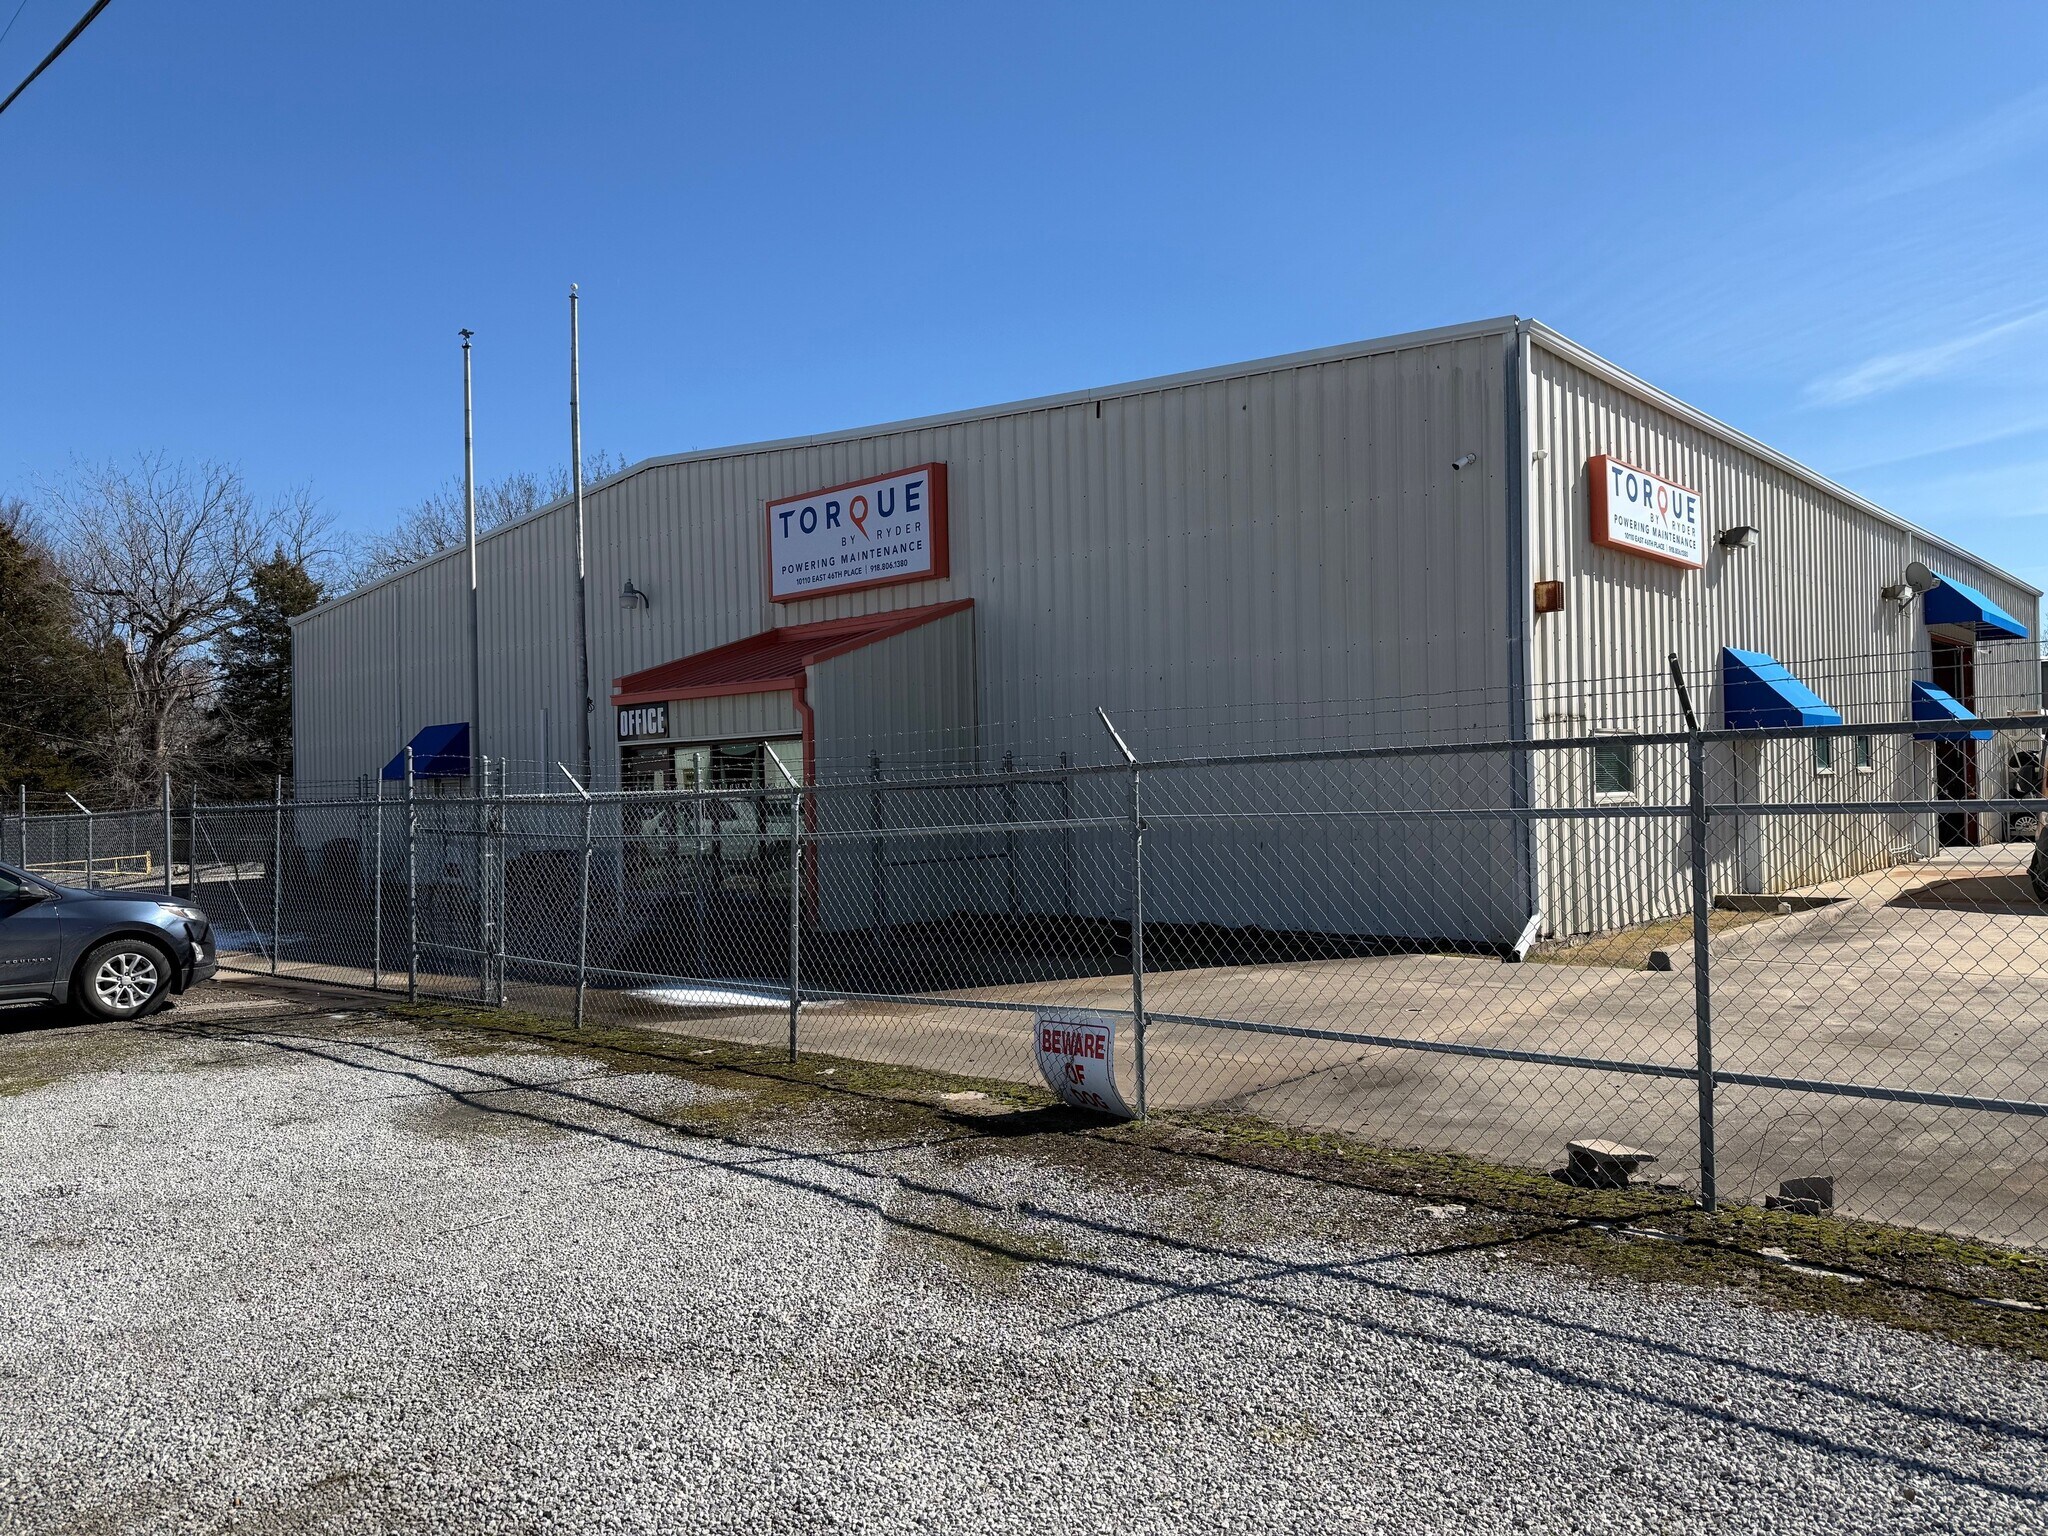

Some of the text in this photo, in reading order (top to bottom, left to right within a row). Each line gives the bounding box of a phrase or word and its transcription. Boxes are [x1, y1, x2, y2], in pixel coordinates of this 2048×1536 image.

[1612, 466, 1696, 526] TORQUE
[779, 480, 924, 541] TORQUE
[841, 521, 921, 547] BY RYDER
[1614, 514, 1696, 549] POWERING MAINTENANCE
[1650, 513, 1696, 537] BY RYDER
[1635, 535, 1644, 544] EAST
[781, 540, 923, 575] POWERING MAINTENANCE
[796, 559, 908, 585] 10110 EAST 46TH PLACE 918.806.1380
[620, 708, 664, 736] OFFICE
[1042, 1029, 1106, 1060] BEWARE
[1065, 1063, 1085, 1085] OF
